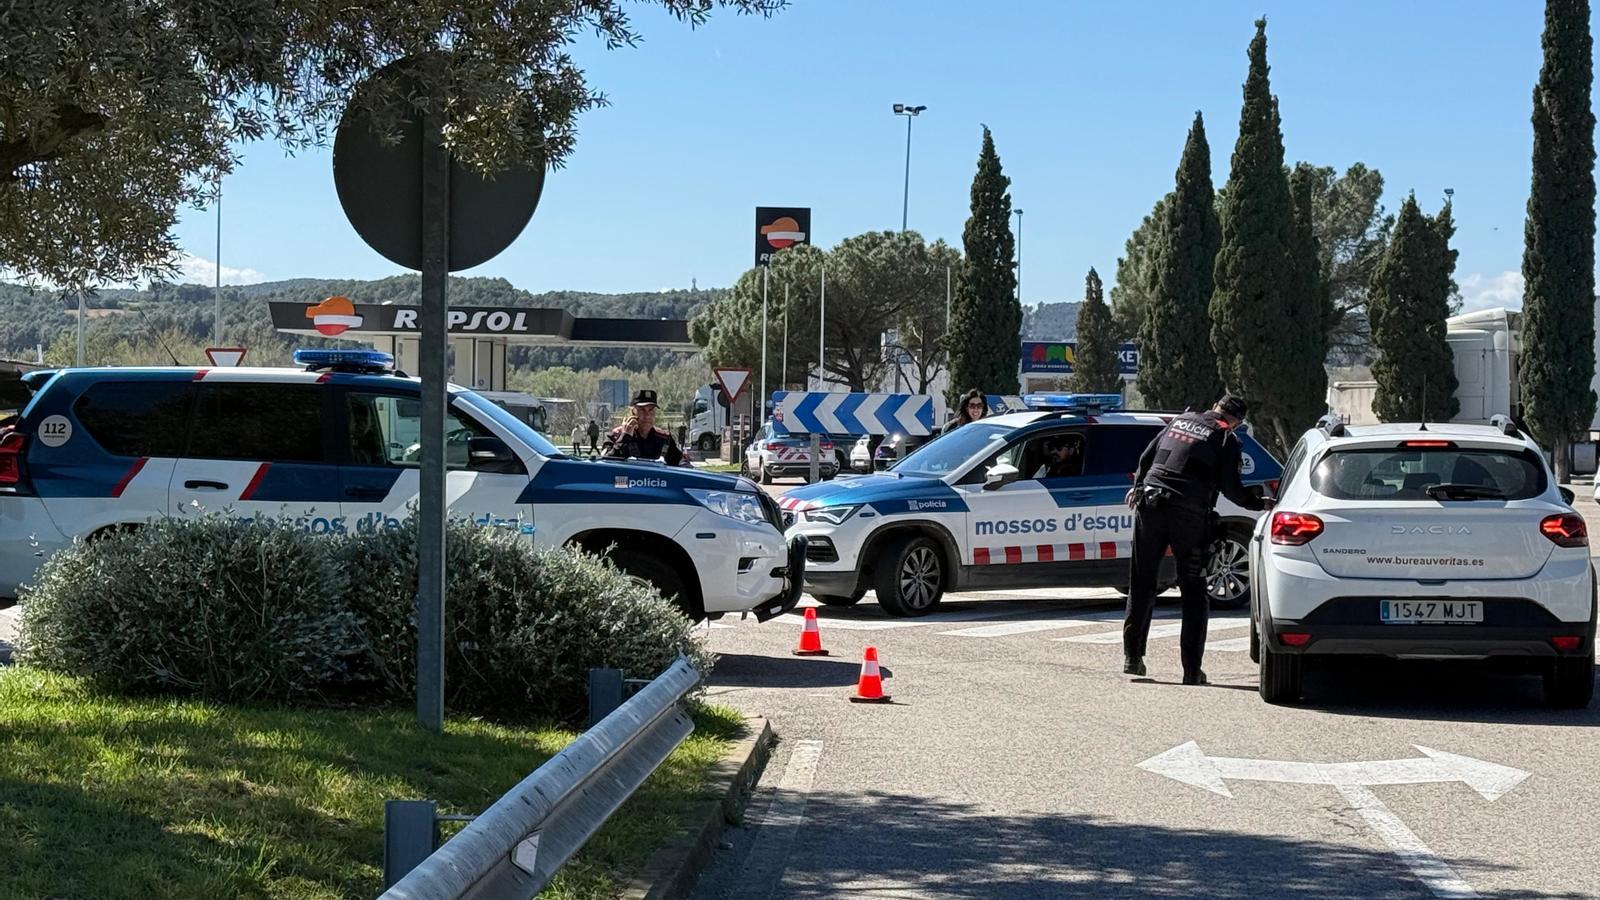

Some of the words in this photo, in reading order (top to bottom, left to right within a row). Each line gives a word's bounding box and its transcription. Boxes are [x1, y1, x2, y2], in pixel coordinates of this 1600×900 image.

[393, 309, 528, 331] RPSOL
[44, 423, 66, 434] 112
[629, 477, 667, 488] policia
[975, 518, 1057, 535] mossos
[1064, 513, 1132, 533] d'esqu
[1391, 525, 1471, 534] DACIA
[1323, 547, 1366, 555] SANDERO
[1367, 555, 1484, 567] www.bureauveritas.es
[1393, 603, 1437, 618] 1547
[1443, 603, 1477, 618] MJT
